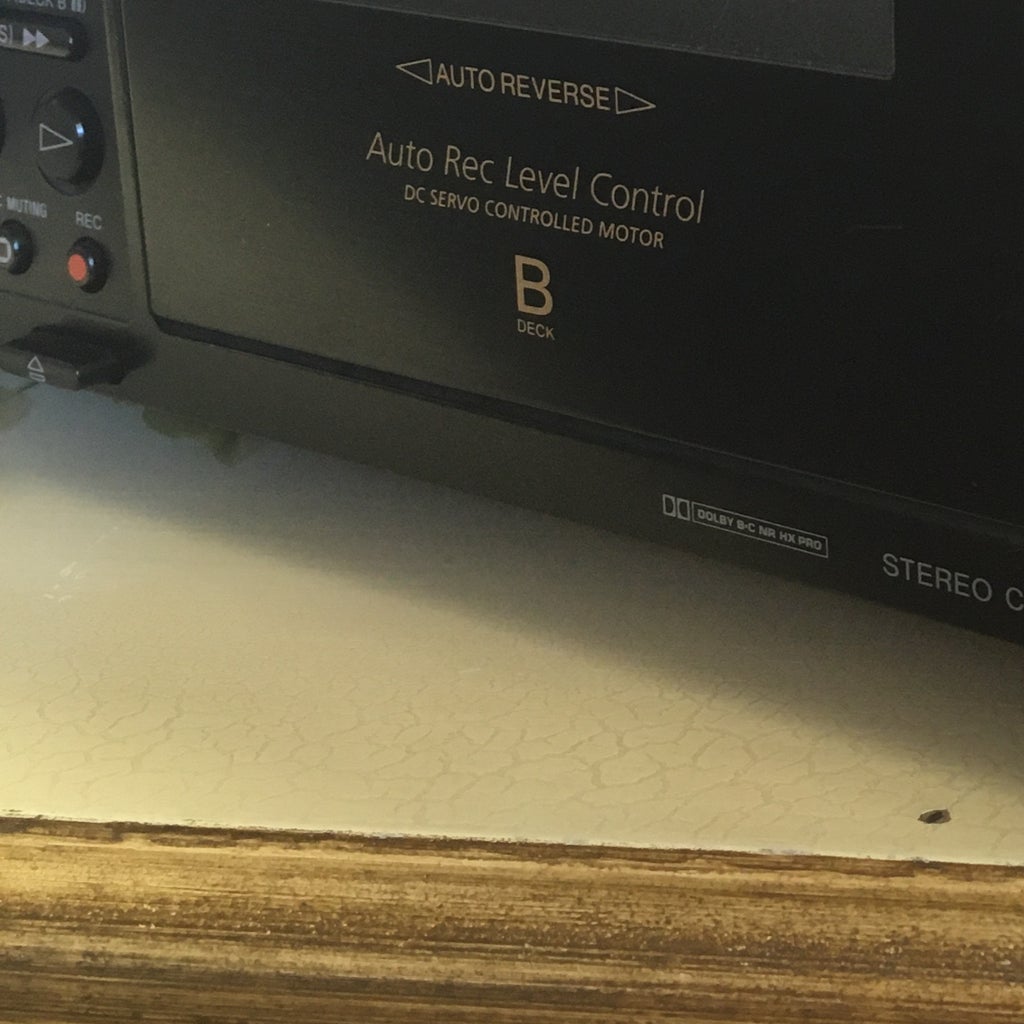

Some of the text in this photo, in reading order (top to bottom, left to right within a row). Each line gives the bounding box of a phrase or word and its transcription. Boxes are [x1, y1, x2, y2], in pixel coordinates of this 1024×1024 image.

[436, 62, 611, 111] AUTO REVERSE
[366, 131, 705, 224] Auto Rec Level Control
[75, 211, 102, 230] REC
[404, 184, 664, 249] DC SERVO CONTROLLED MOTOR
[514, 254, 554, 316] B
[517, 318, 555, 341] DECK
[697, 508, 735, 526] DOLBY
[758, 525, 776, 539] NR
[779, 531, 796, 544] HX
[798, 536, 823, 551] PRO
[882, 552, 993, 603] STEREO
